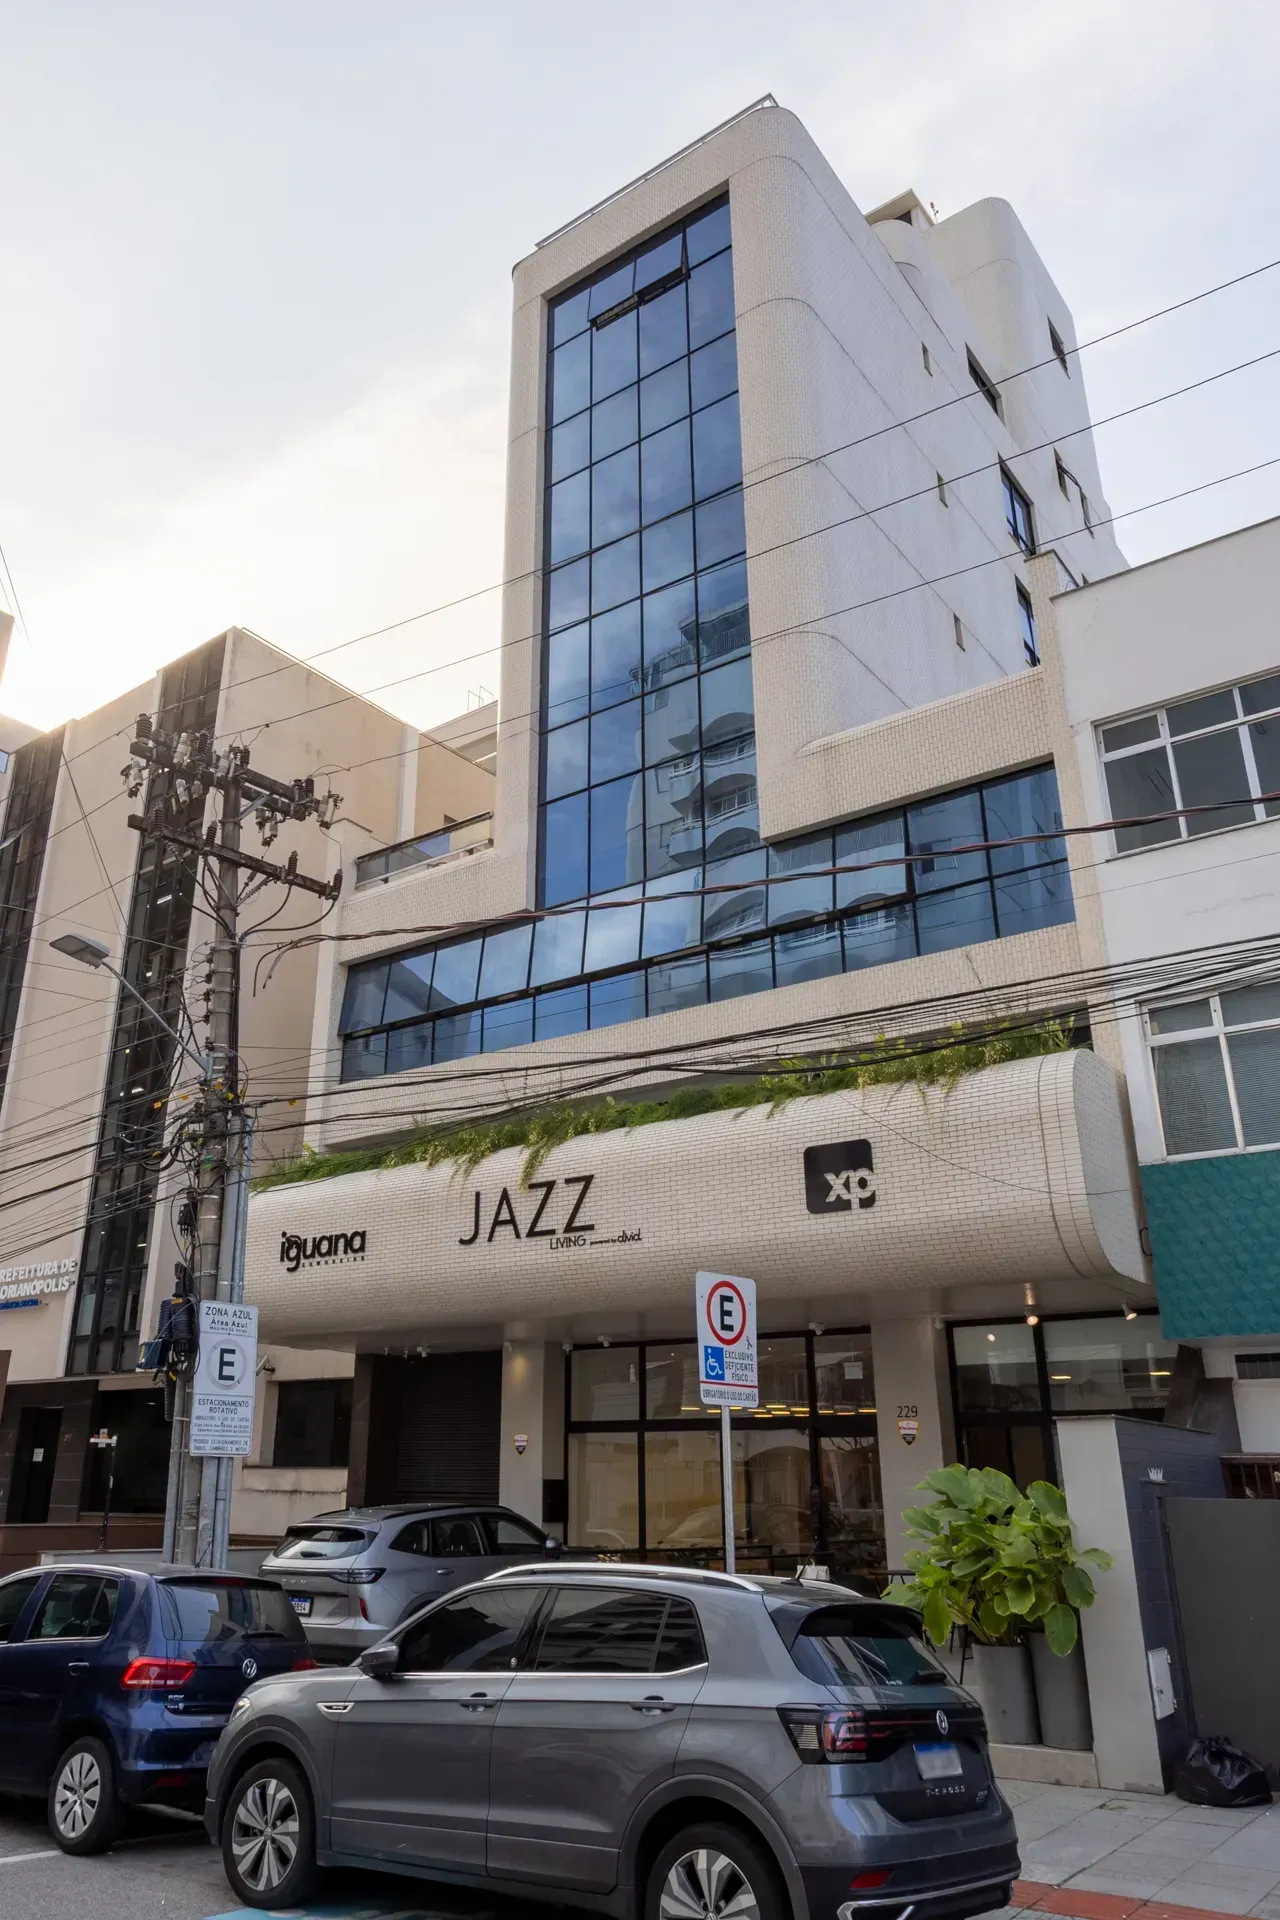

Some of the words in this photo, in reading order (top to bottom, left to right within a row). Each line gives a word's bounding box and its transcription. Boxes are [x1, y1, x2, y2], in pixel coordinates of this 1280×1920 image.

[458, 1174, 595, 1246] JAZZ
[550, 1235, 587, 1250] LIVING
[280, 1230, 367, 1273] iguana
[60, 1258, 77, 1273] DE
[206, 1306, 228, 1317] ZONA
[232, 1309, 252, 1320] AZUL
[719, 1294, 734, 1332] E
[211, 1316, 228, 1326] Área
[231, 1320, 248, 1328] Azul
[724, 1350, 754, 1362] EXCLUSIVO
[218, 1347, 236, 1382] E
[724, 1361, 754, 1373] DEFICIENTE
[198, 1399, 249, 1408] ESTACIONAMENTO
[896, 1405, 918, 1418] 229
